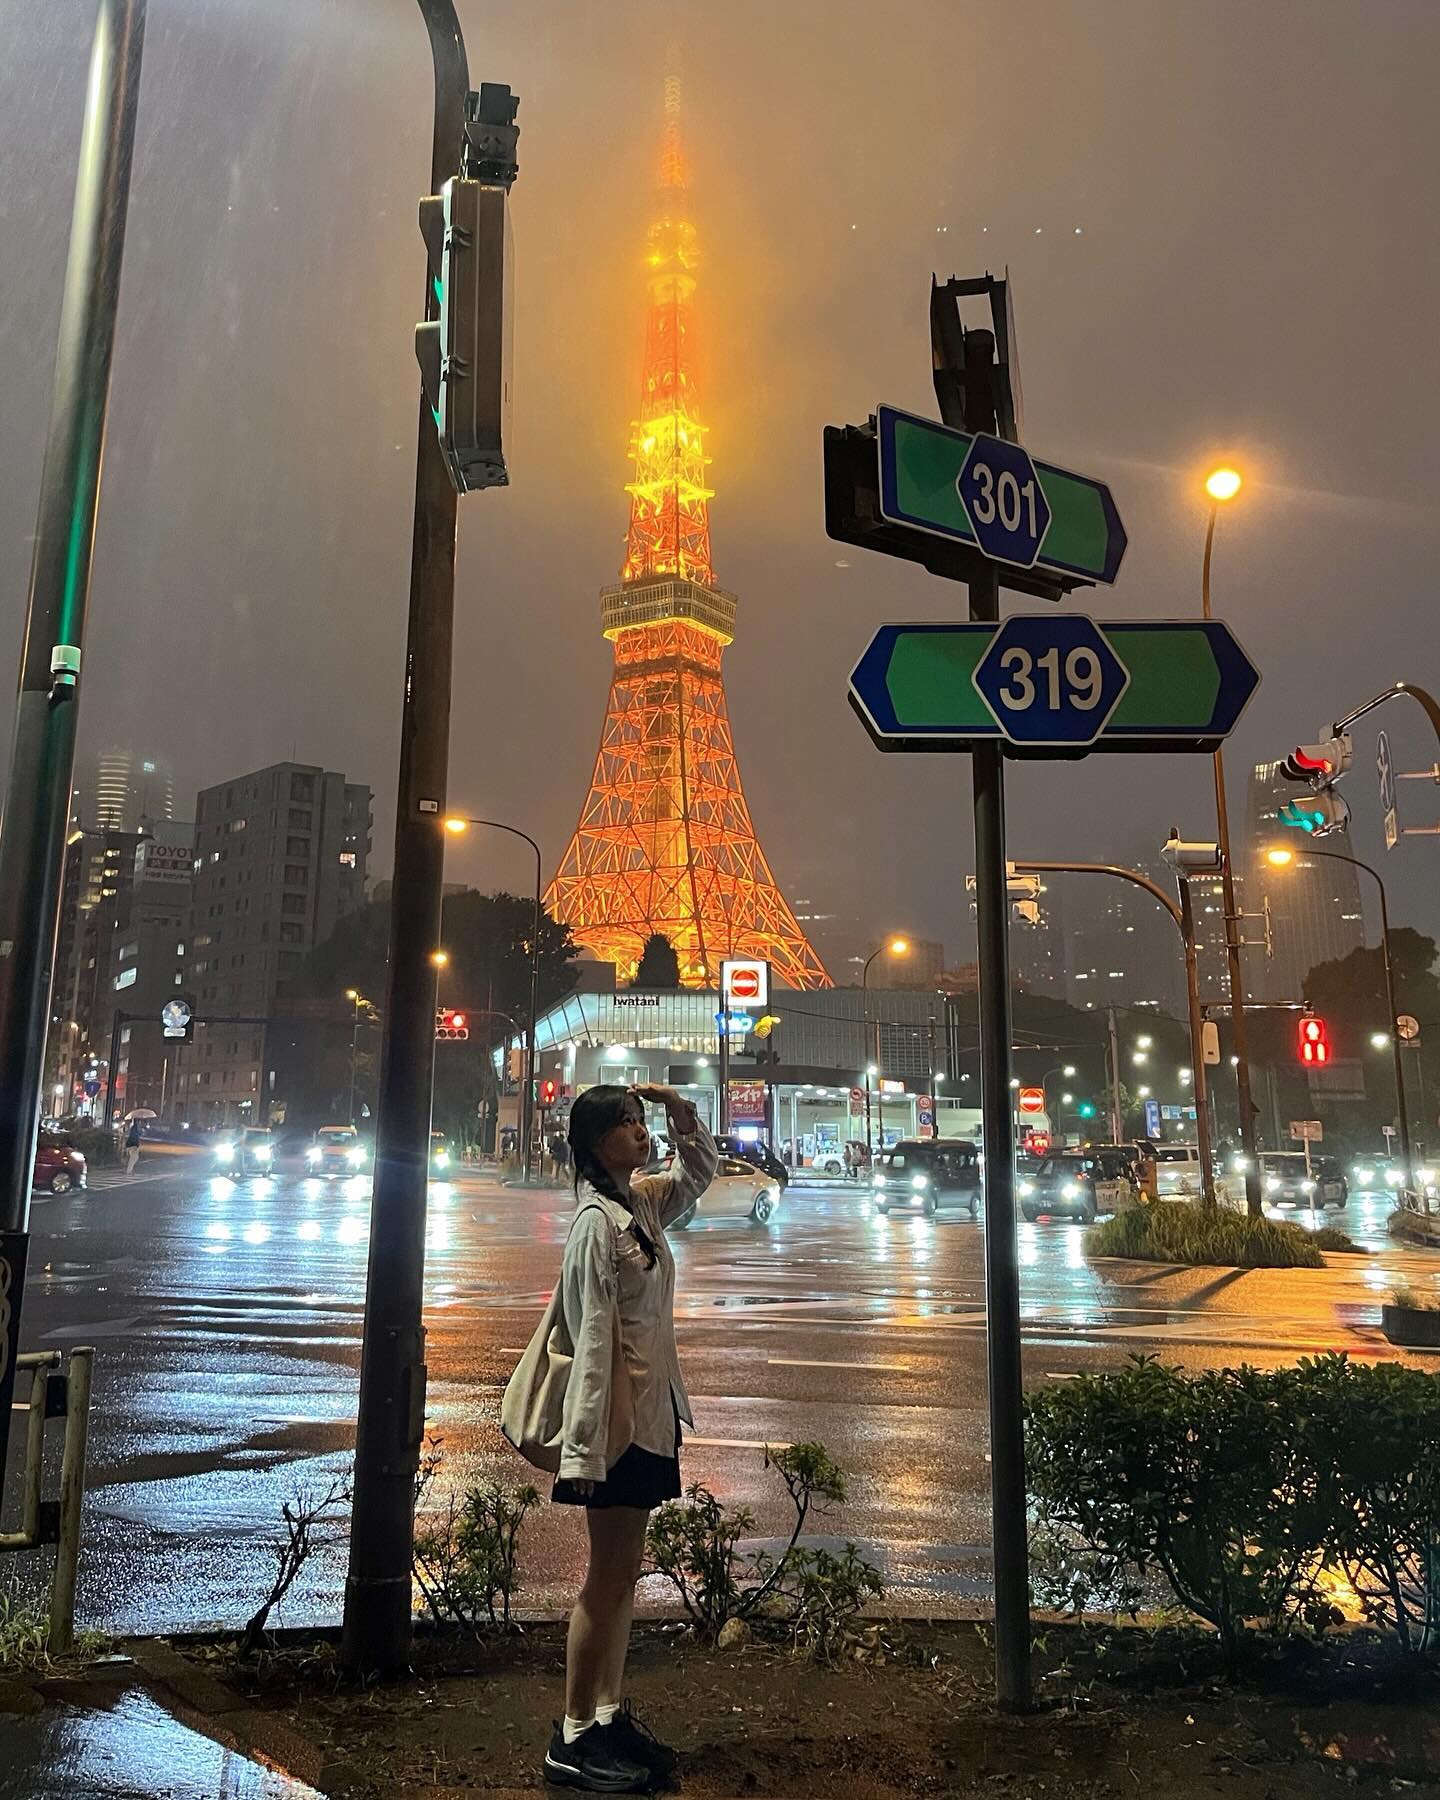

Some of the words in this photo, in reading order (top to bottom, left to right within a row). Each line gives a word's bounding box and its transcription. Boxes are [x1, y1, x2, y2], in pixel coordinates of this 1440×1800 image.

[971, 462, 1037, 539] 301
[999, 646, 1103, 711] 319
[613, 995, 660, 1006] Iwatani
